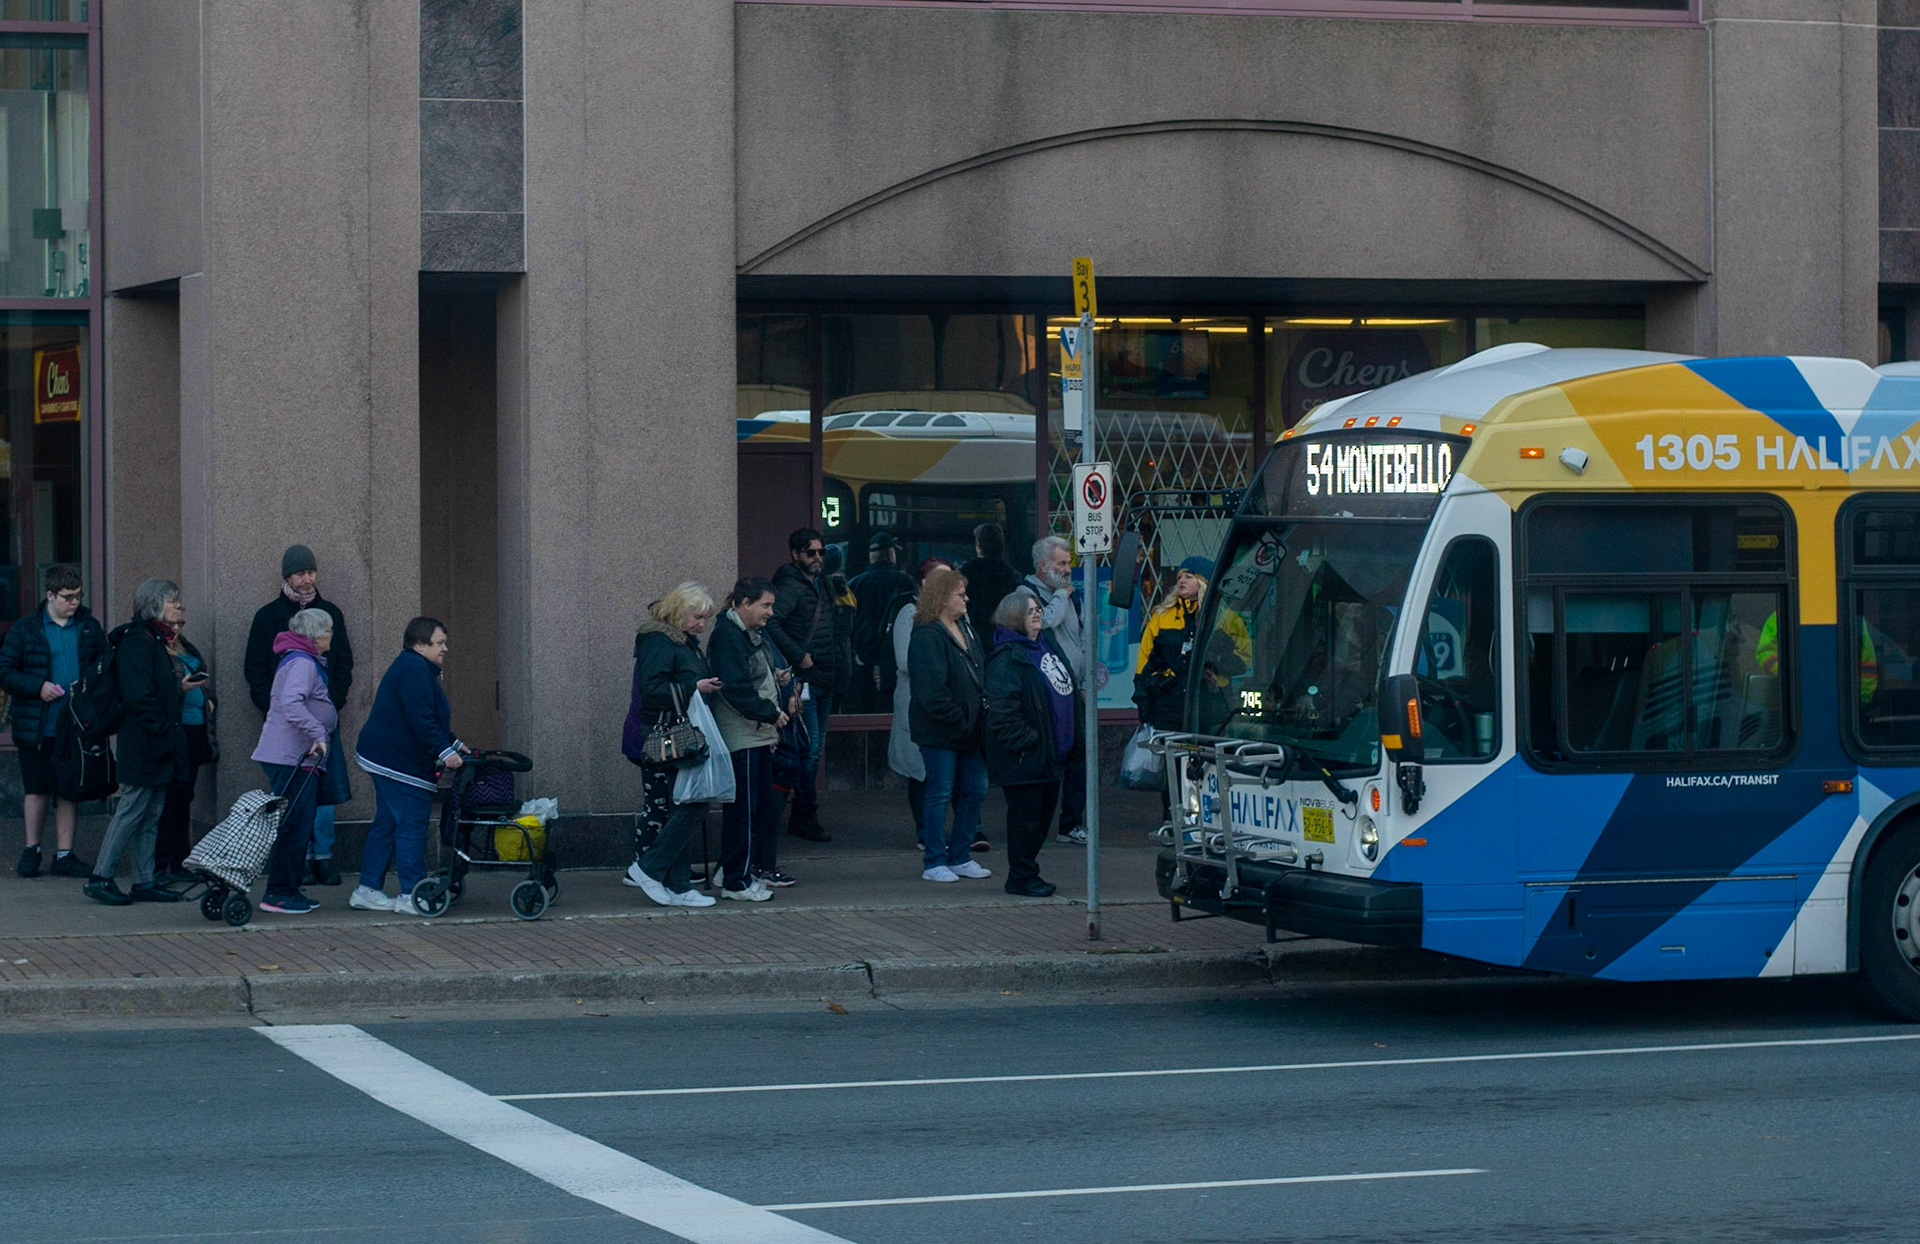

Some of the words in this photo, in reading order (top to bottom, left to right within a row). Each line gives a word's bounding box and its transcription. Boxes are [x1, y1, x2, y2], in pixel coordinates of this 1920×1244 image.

[1076, 261, 1089, 280] Bay
[1080, 281, 1090, 313] 3
[1299, 347, 1412, 389] Chens
[1635, 433, 1742, 470] 1305
[1756, 435, 1920, 470] HALIFAX
[1306, 443, 1334, 495] 54
[1336, 442, 1452, 494] MONTEBELLO
[1085, 525, 1104, 535] STOP
[1087, 512, 1102, 522] BUS
[1666, 774, 1779, 787] HALIFAX.CA/TRANSIT
[1230, 790, 1300, 833] HALIFAX
